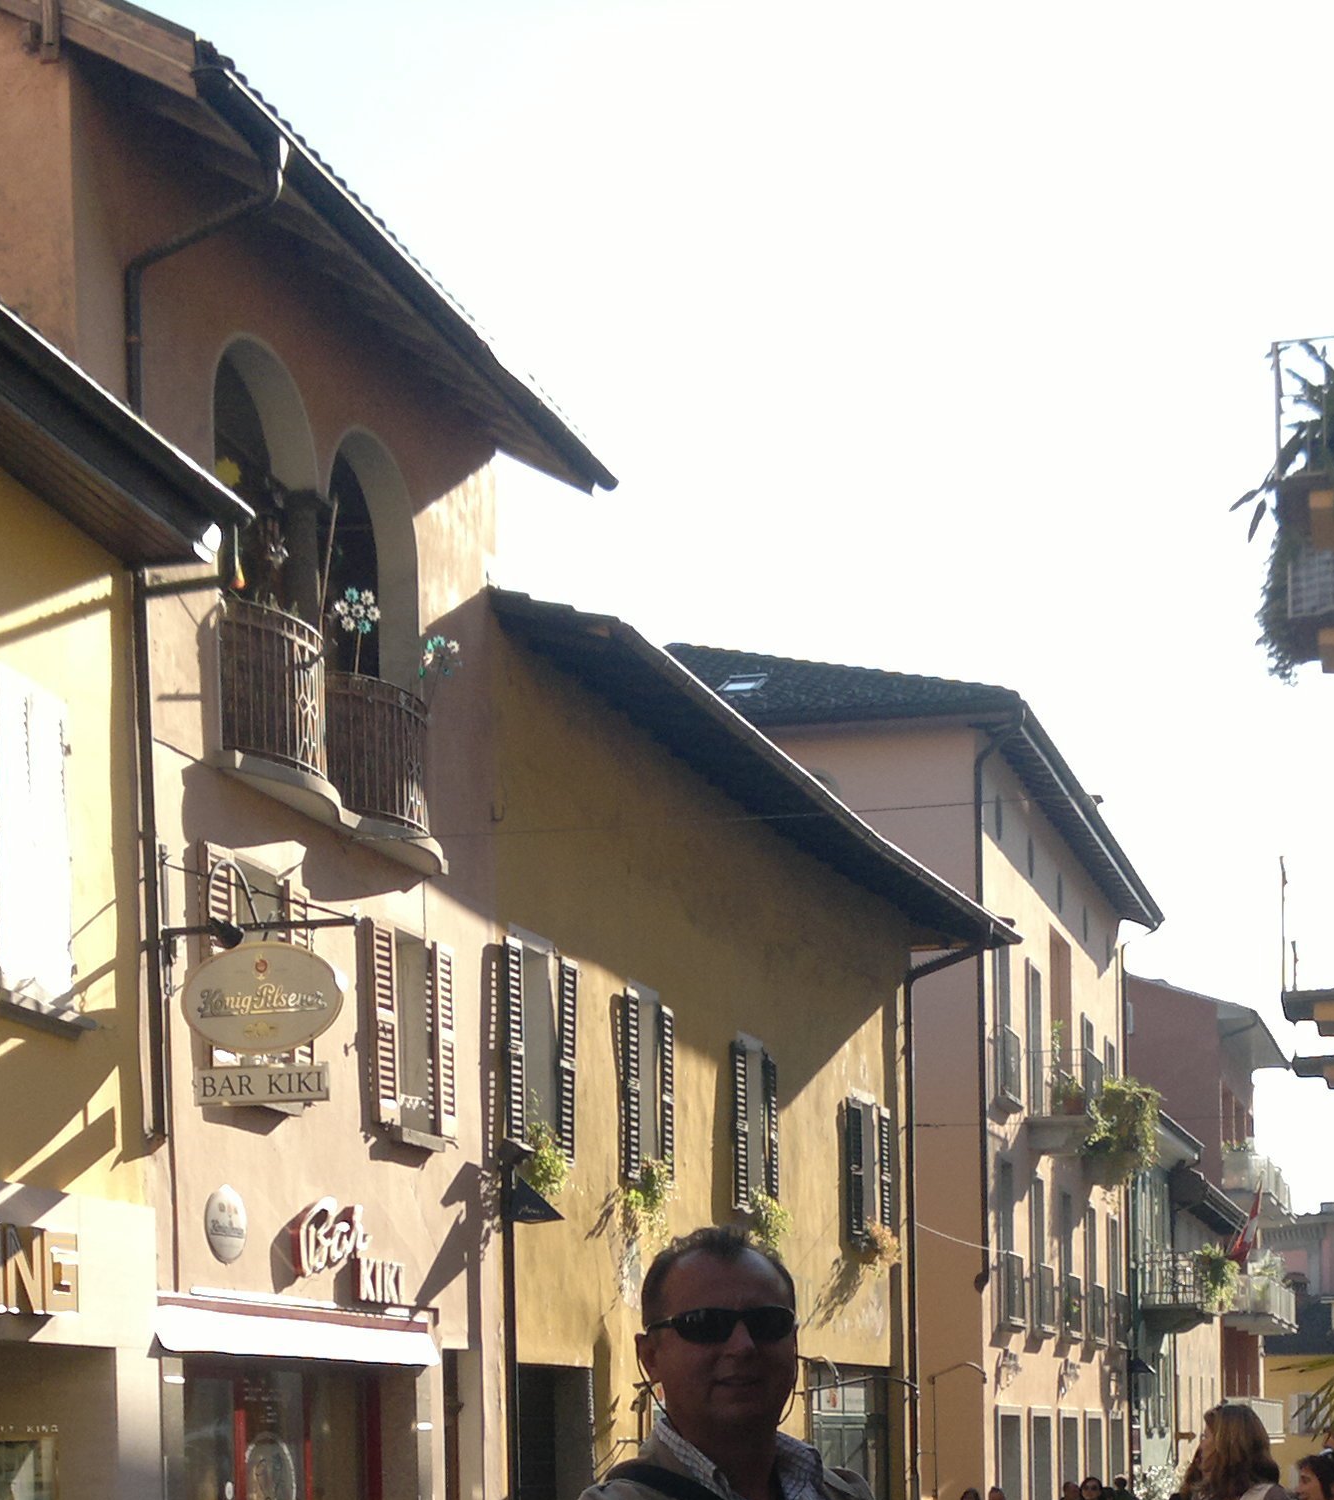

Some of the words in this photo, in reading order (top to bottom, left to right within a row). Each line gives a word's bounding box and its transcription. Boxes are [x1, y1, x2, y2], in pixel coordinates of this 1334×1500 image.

[201, 1073, 256, 1099] BAR
[267, 1070, 324, 1096] KIKI
[358, 1256, 408, 1304] KIKI
